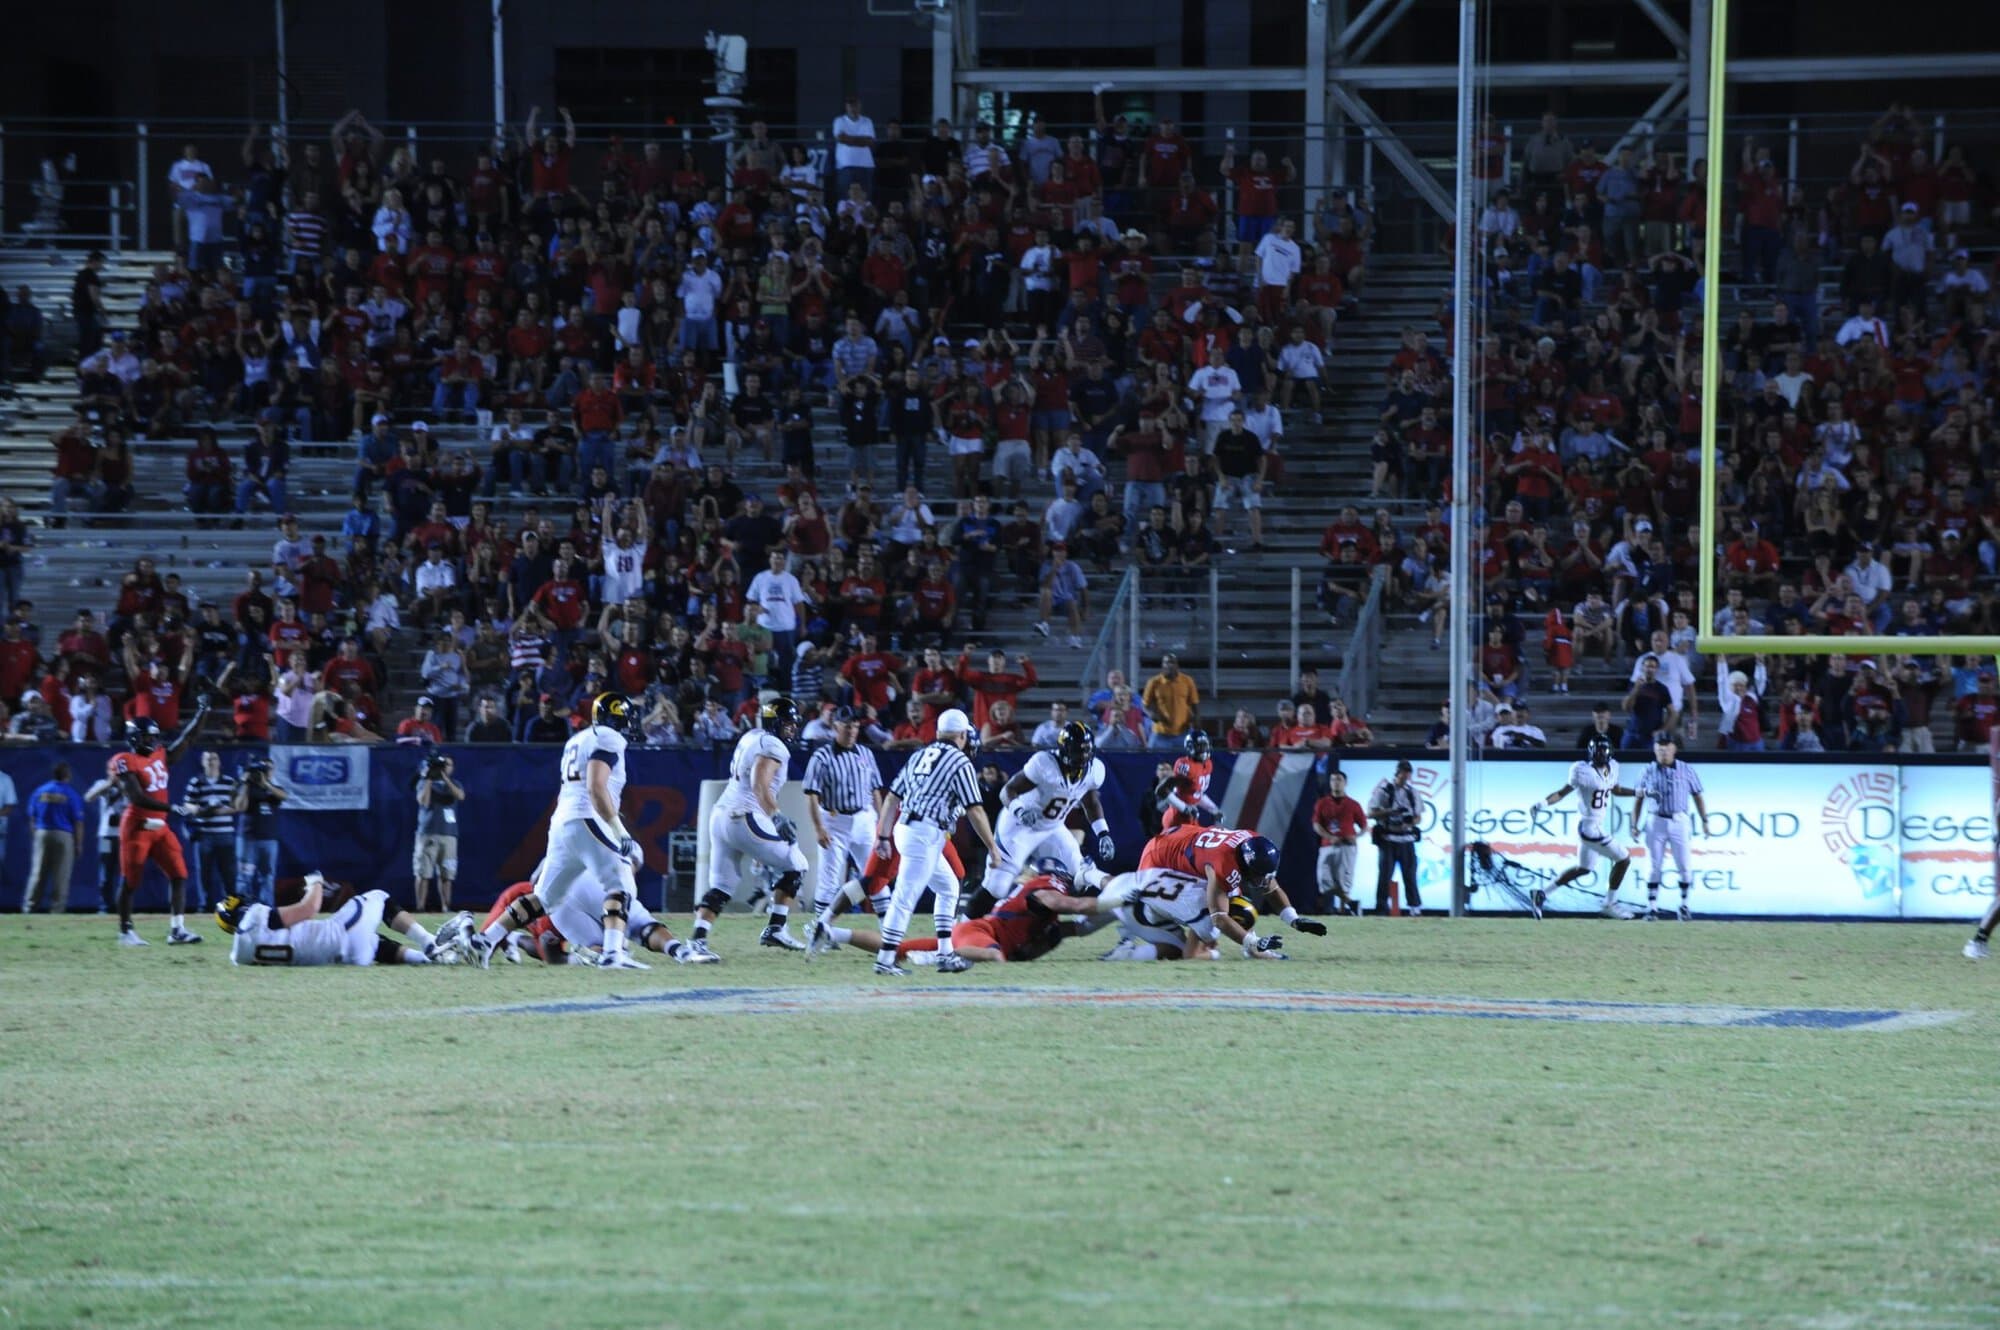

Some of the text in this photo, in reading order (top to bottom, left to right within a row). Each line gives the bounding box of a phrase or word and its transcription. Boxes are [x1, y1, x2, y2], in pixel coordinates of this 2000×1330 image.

[144, 759, 169, 792] 15
[561, 744, 581, 785] 2
[1612, 803, 1800, 838] IOND
[1141, 871, 1200, 902] 13
